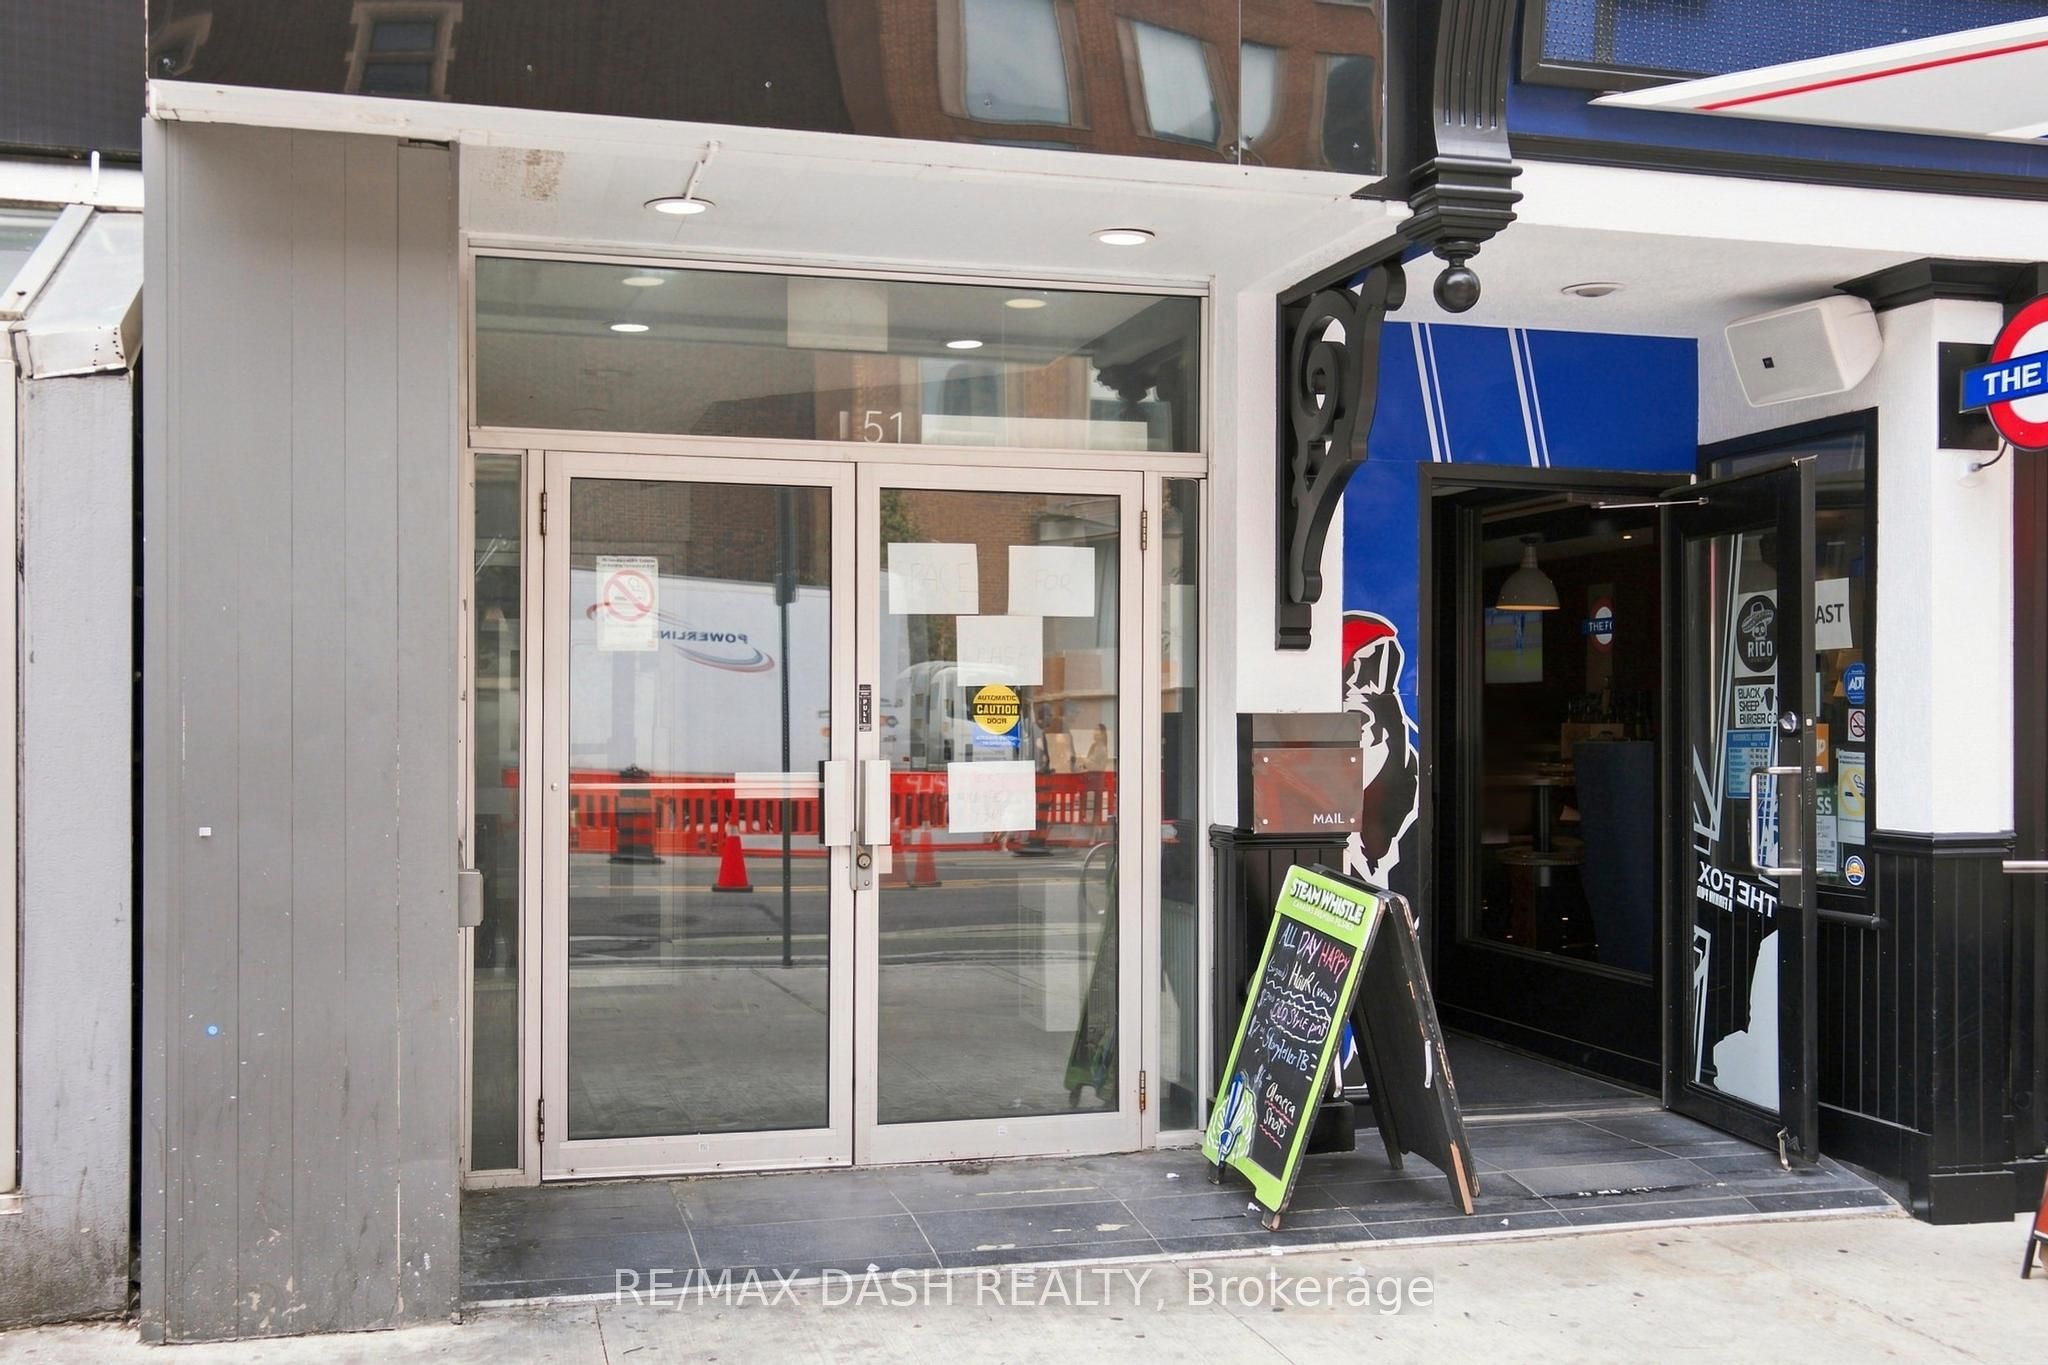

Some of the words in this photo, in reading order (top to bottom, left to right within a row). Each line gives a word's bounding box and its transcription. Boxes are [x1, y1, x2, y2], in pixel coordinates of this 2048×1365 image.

[1983, 361, 2042, 396] THE
[863, 409, 902, 444] 51
[1815, 603, 1845, 625] AST
[1747, 640, 1773, 658] RICO
[1737, 687, 1761, 700] BLACK
[976, 704, 1018, 715] CAUTION
[1739, 700, 1760, 712] SHEEP
[1739, 712, 1767, 725] BURGER
[1816, 796, 1832, 815] SS
[1312, 812, 1345, 825] MAIL
[1289, 877, 1323, 908] STEAM
[1319, 888, 1367, 926] WHISTLE
[1279, 922, 1298, 948] ALL
[1296, 930, 1322, 964] DAY
[1317, 943, 1350, 983] HAPPY
